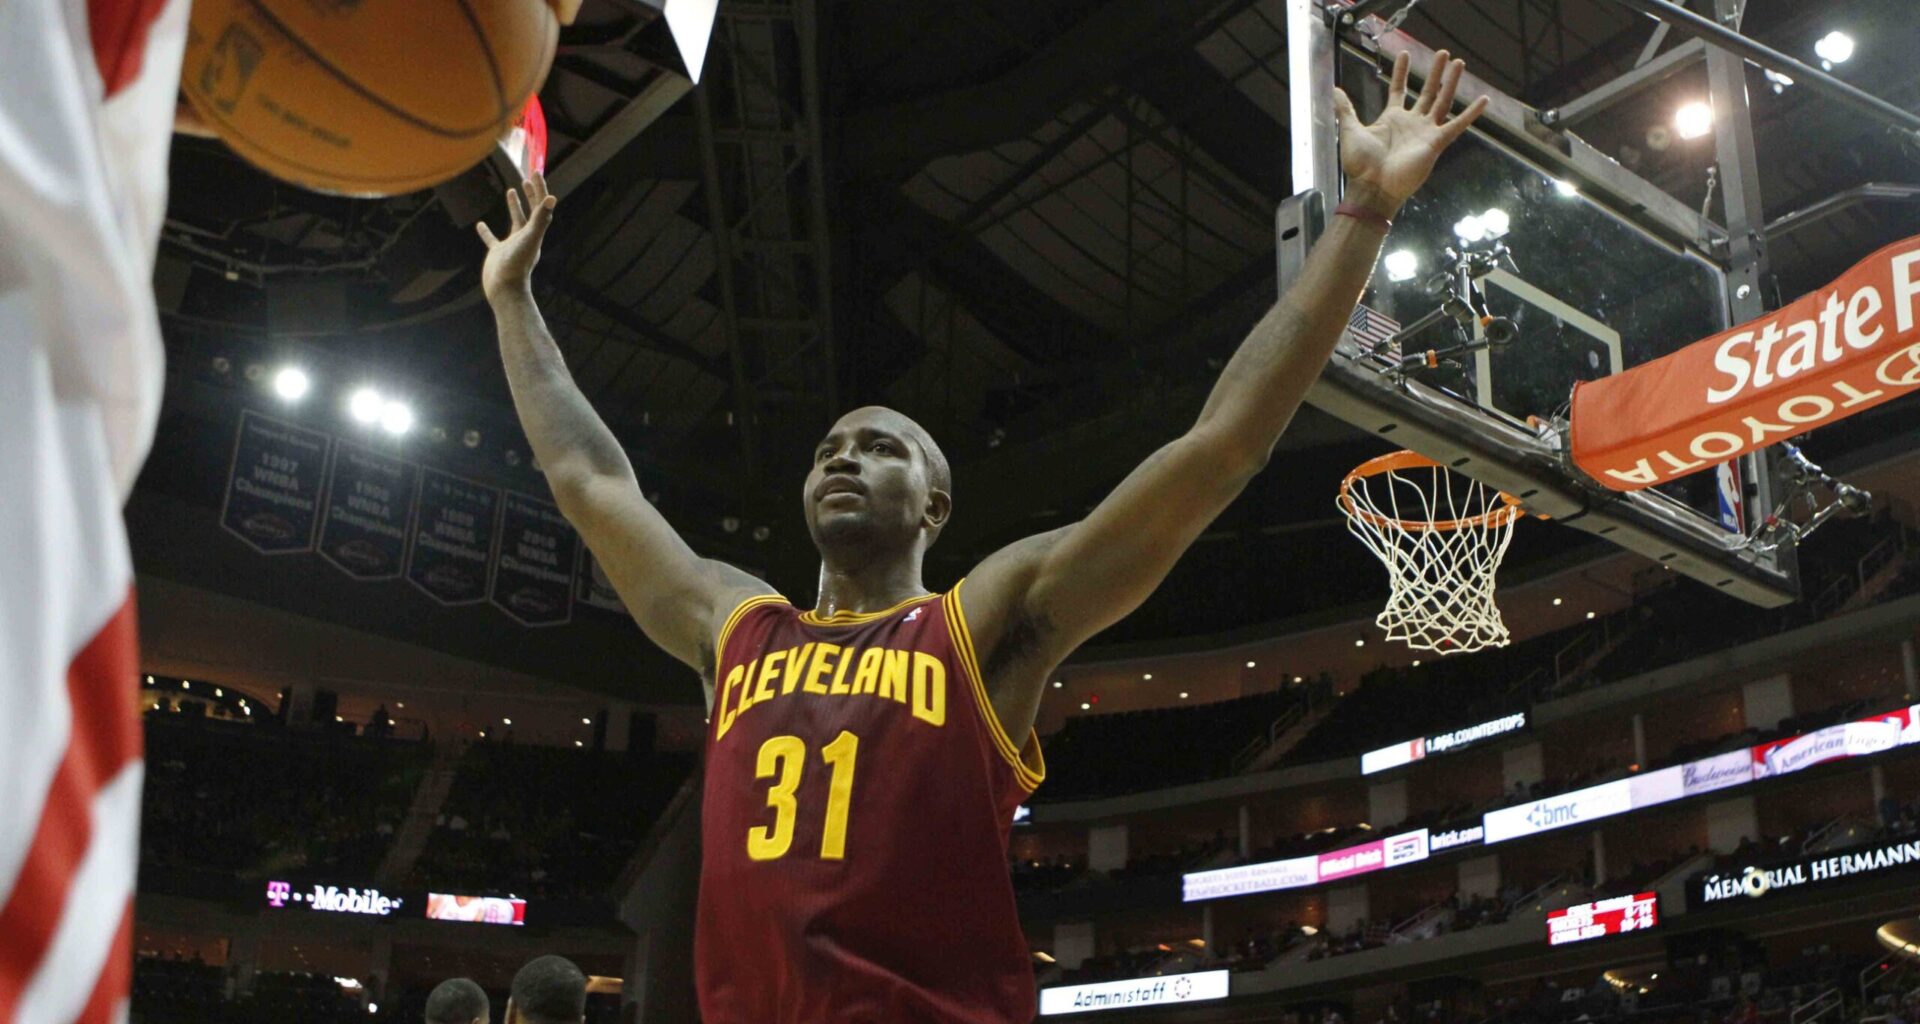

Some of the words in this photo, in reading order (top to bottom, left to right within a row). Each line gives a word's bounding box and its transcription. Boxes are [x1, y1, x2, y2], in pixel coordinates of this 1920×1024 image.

[1707, 285, 1884, 404] State
[1604, 380, 1884, 484] TOYOTA
[253, 465, 300, 491] WNBA
[261, 452, 299, 474] 1997
[235, 477, 313, 511] Champions
[716, 642, 946, 743] CLEVELAND
[1781, 737, 1845, 769] American
[747, 730, 859, 861] 31
[1543, 801, 1579, 826] bmc
[1704, 864, 1807, 902] MEMORIAL
[1811, 840, 1920, 881] HERMANN
[1073, 981, 1167, 1009] Administaff
